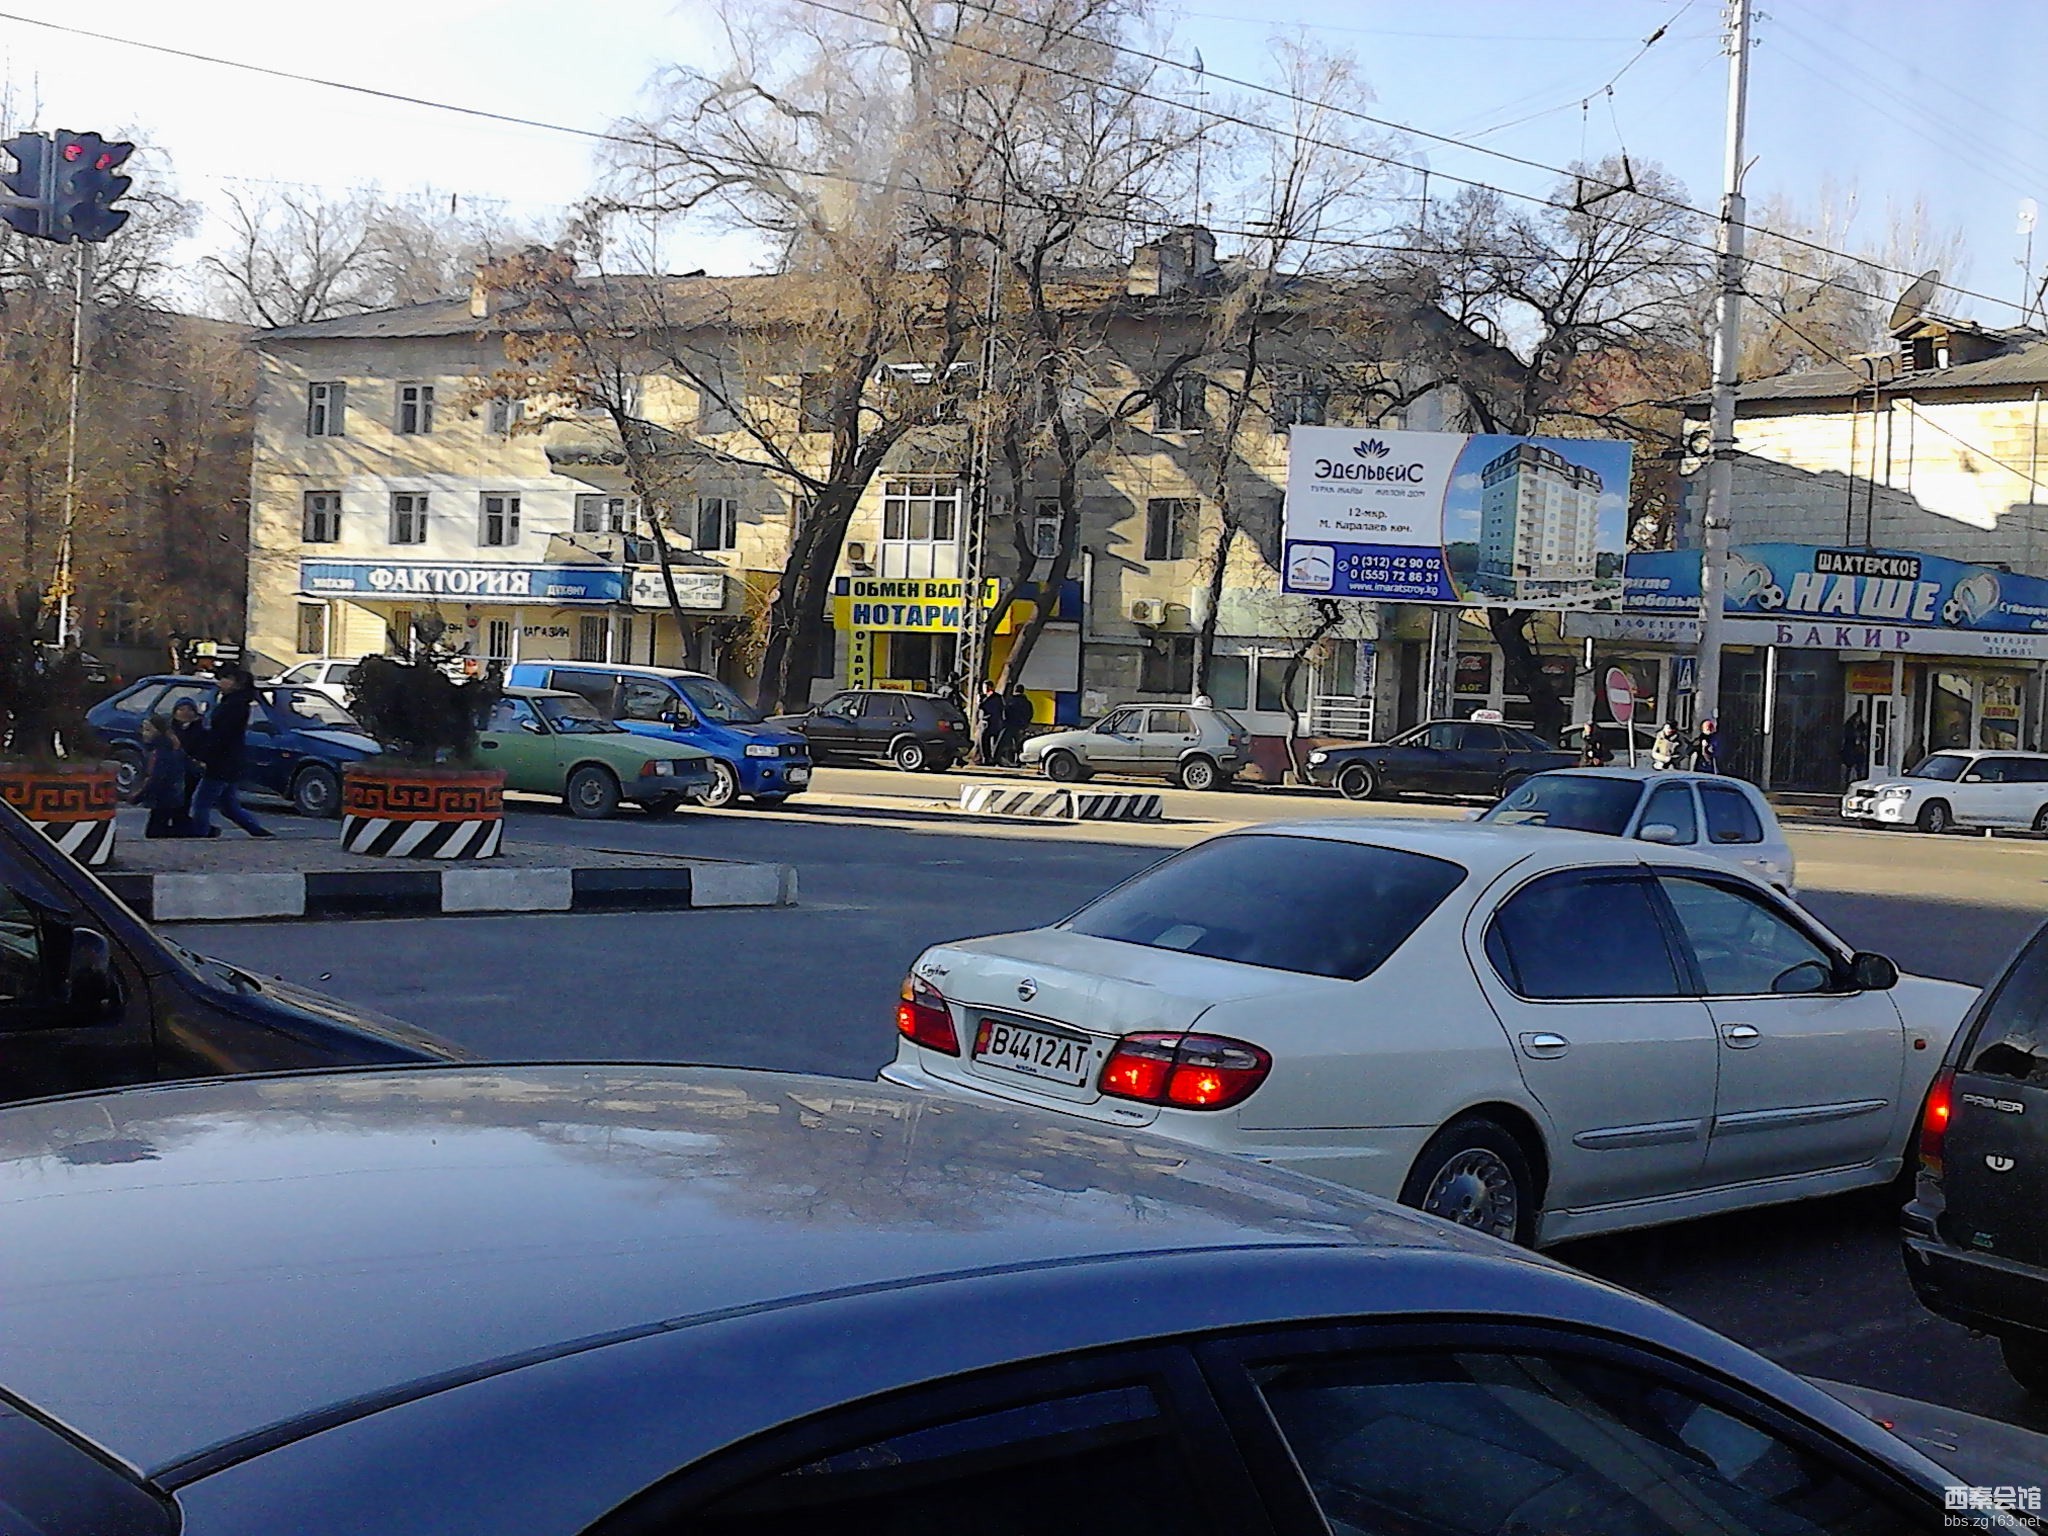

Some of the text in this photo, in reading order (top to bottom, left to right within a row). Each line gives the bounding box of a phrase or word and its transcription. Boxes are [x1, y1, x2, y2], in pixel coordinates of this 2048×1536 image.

[1351, 555, 1440, 570] 0 (312) 42 90 02
[1818, 553, 1918, 578] ШАХТЕРСКОЕ
[368, 568, 531, 595] ФАКТОРИЯ
[1350, 569, 1358, 579] 0
[1361, 569, 1389, 582] (555)
[1392, 571, 1405, 582] 72
[1425, 572, 1439, 583] 31
[853, 581, 996, 600] ОБМЕН ВАЛТ
[1786, 572, 1941, 622] НАШЕ
[1776, 624, 1911, 649] БАКИР
[991, 1027, 1089, 1074] B4412AT
